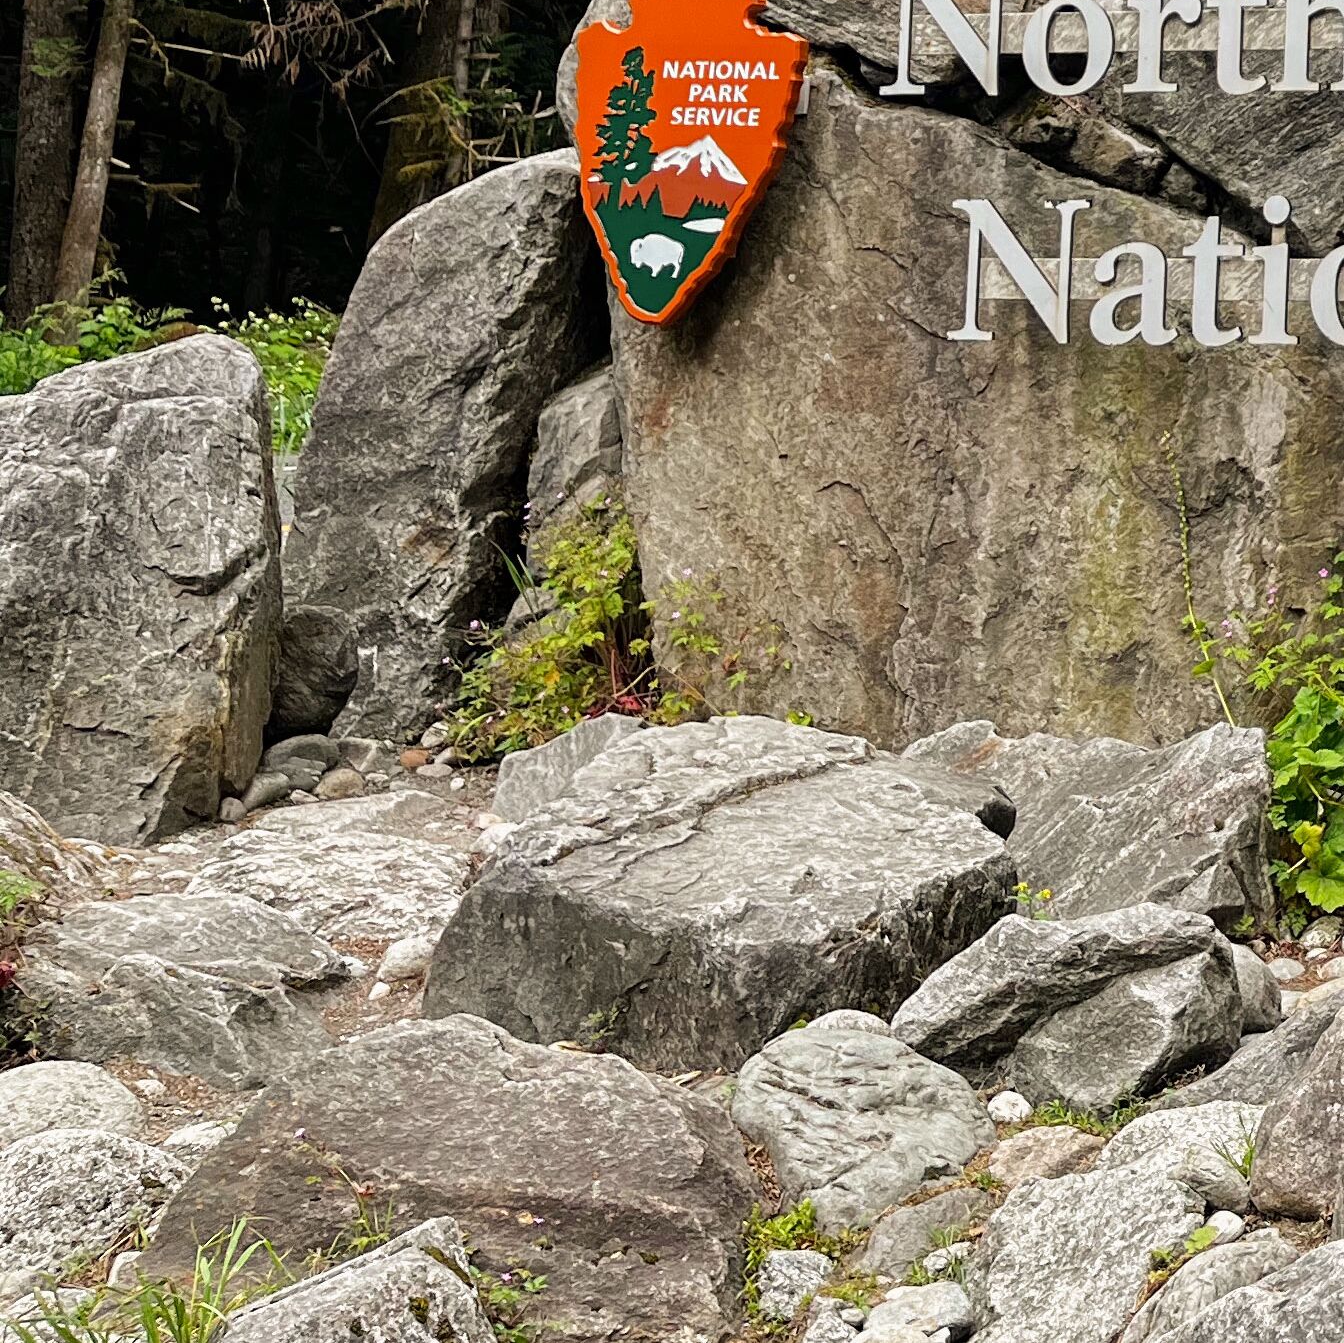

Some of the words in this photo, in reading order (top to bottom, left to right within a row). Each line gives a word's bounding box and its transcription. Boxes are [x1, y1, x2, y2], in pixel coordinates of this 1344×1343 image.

[662, 61, 780, 80] NATIONAL
[688, 84, 748, 103] PARK
[671, 108, 760, 127] SERVICE
